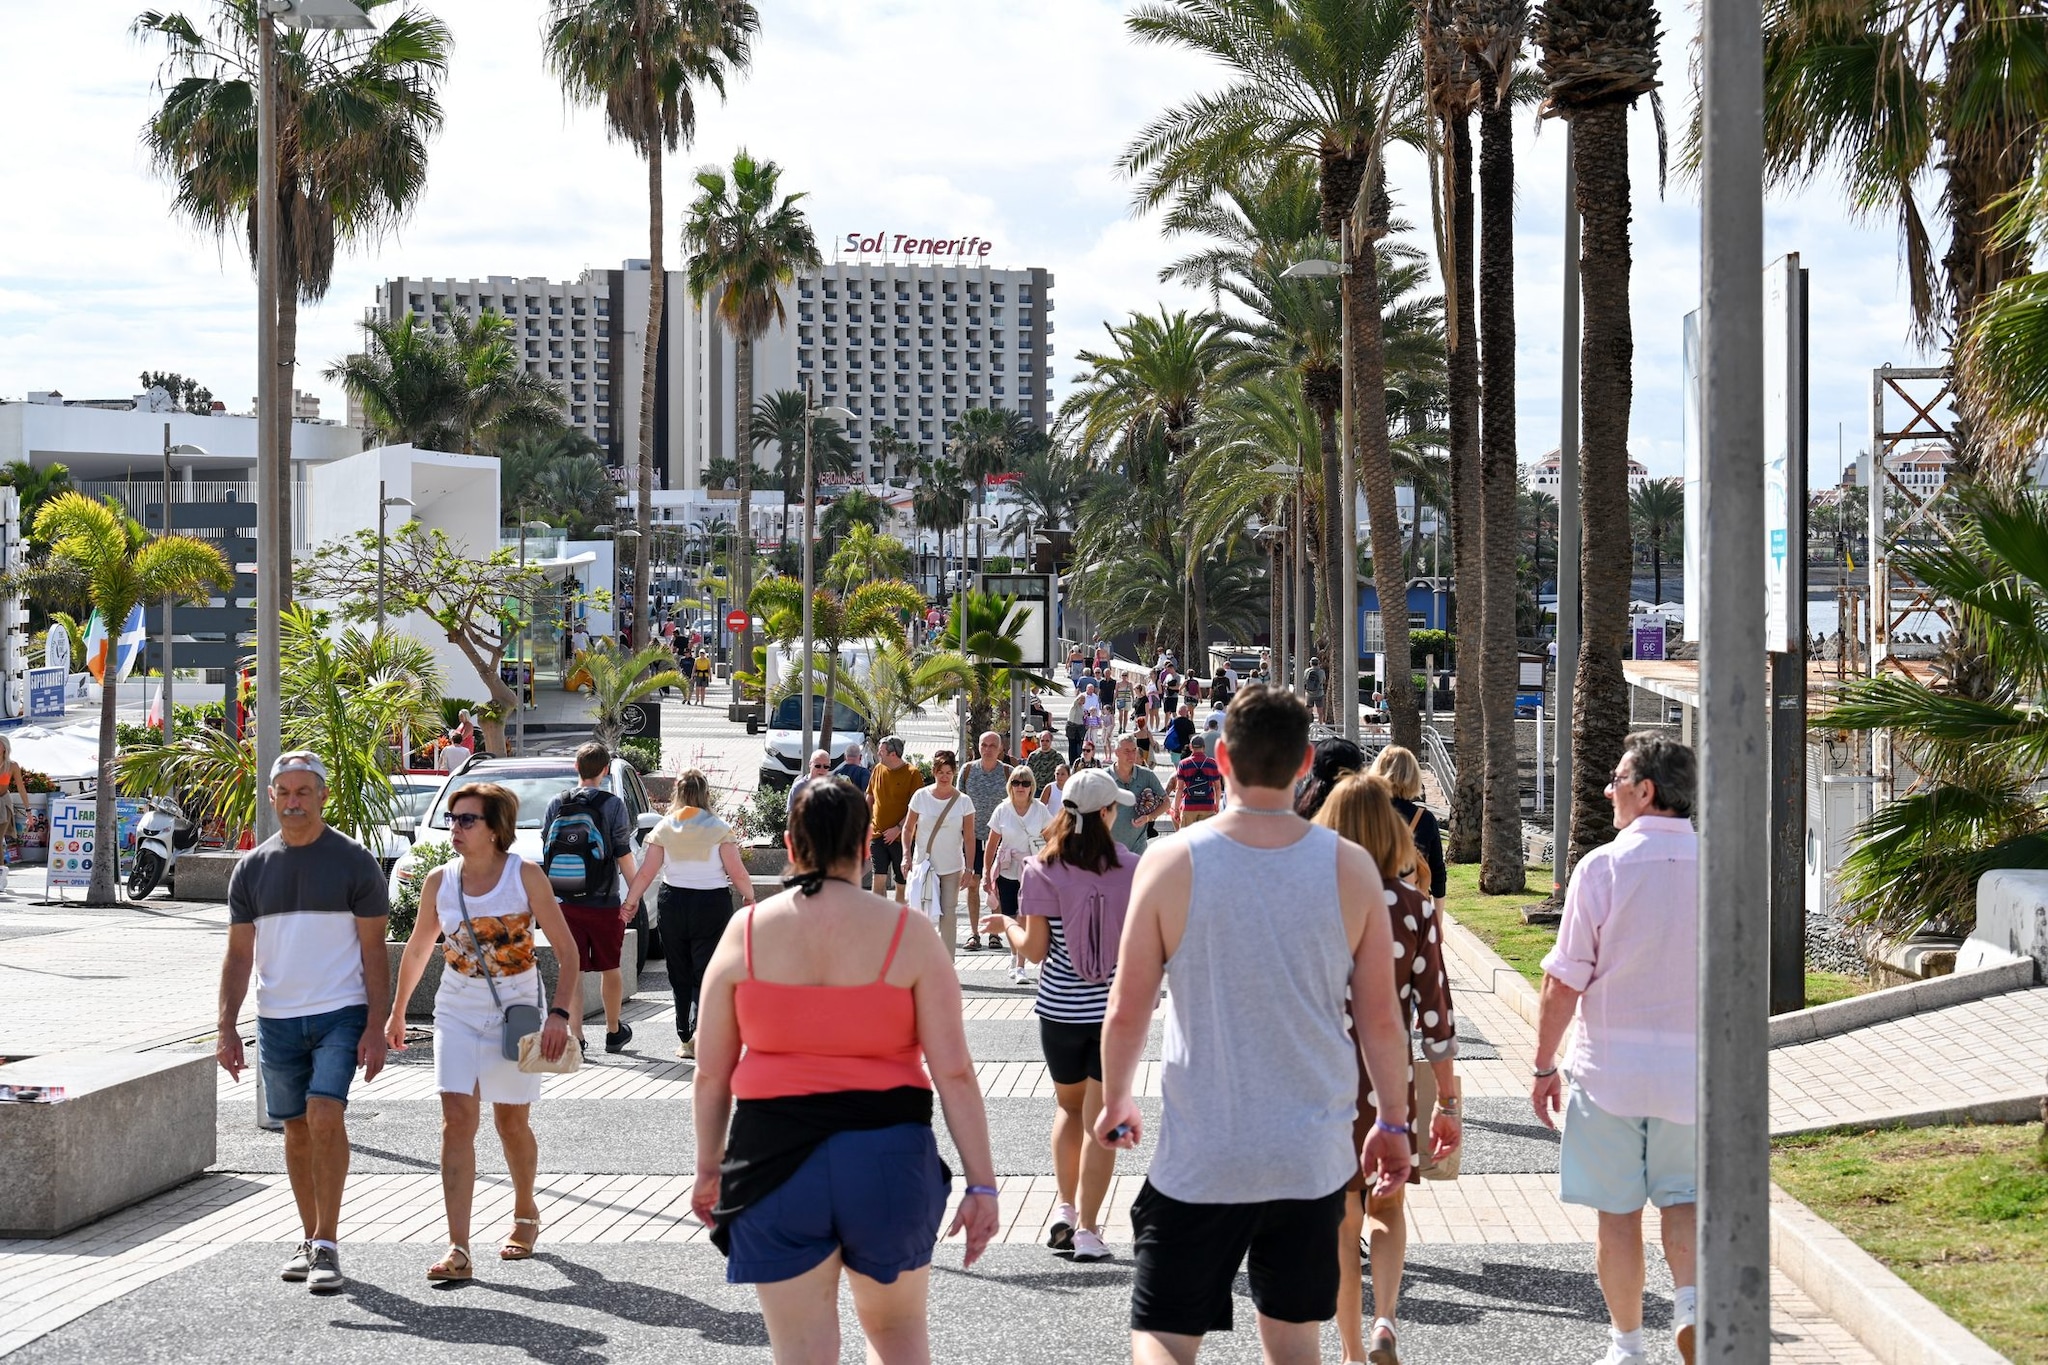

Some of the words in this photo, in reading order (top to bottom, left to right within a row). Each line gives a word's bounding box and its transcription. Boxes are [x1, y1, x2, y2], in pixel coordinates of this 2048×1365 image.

[844, 231, 885, 253] Sol
[893, 234, 992, 256] Tenerife
[1643, 642, 1656, 651] 6€
[31, 671, 63, 690] SUPERMARKET
[78, 810, 95, 820] FAR
[76, 829, 94, 838] HEA
